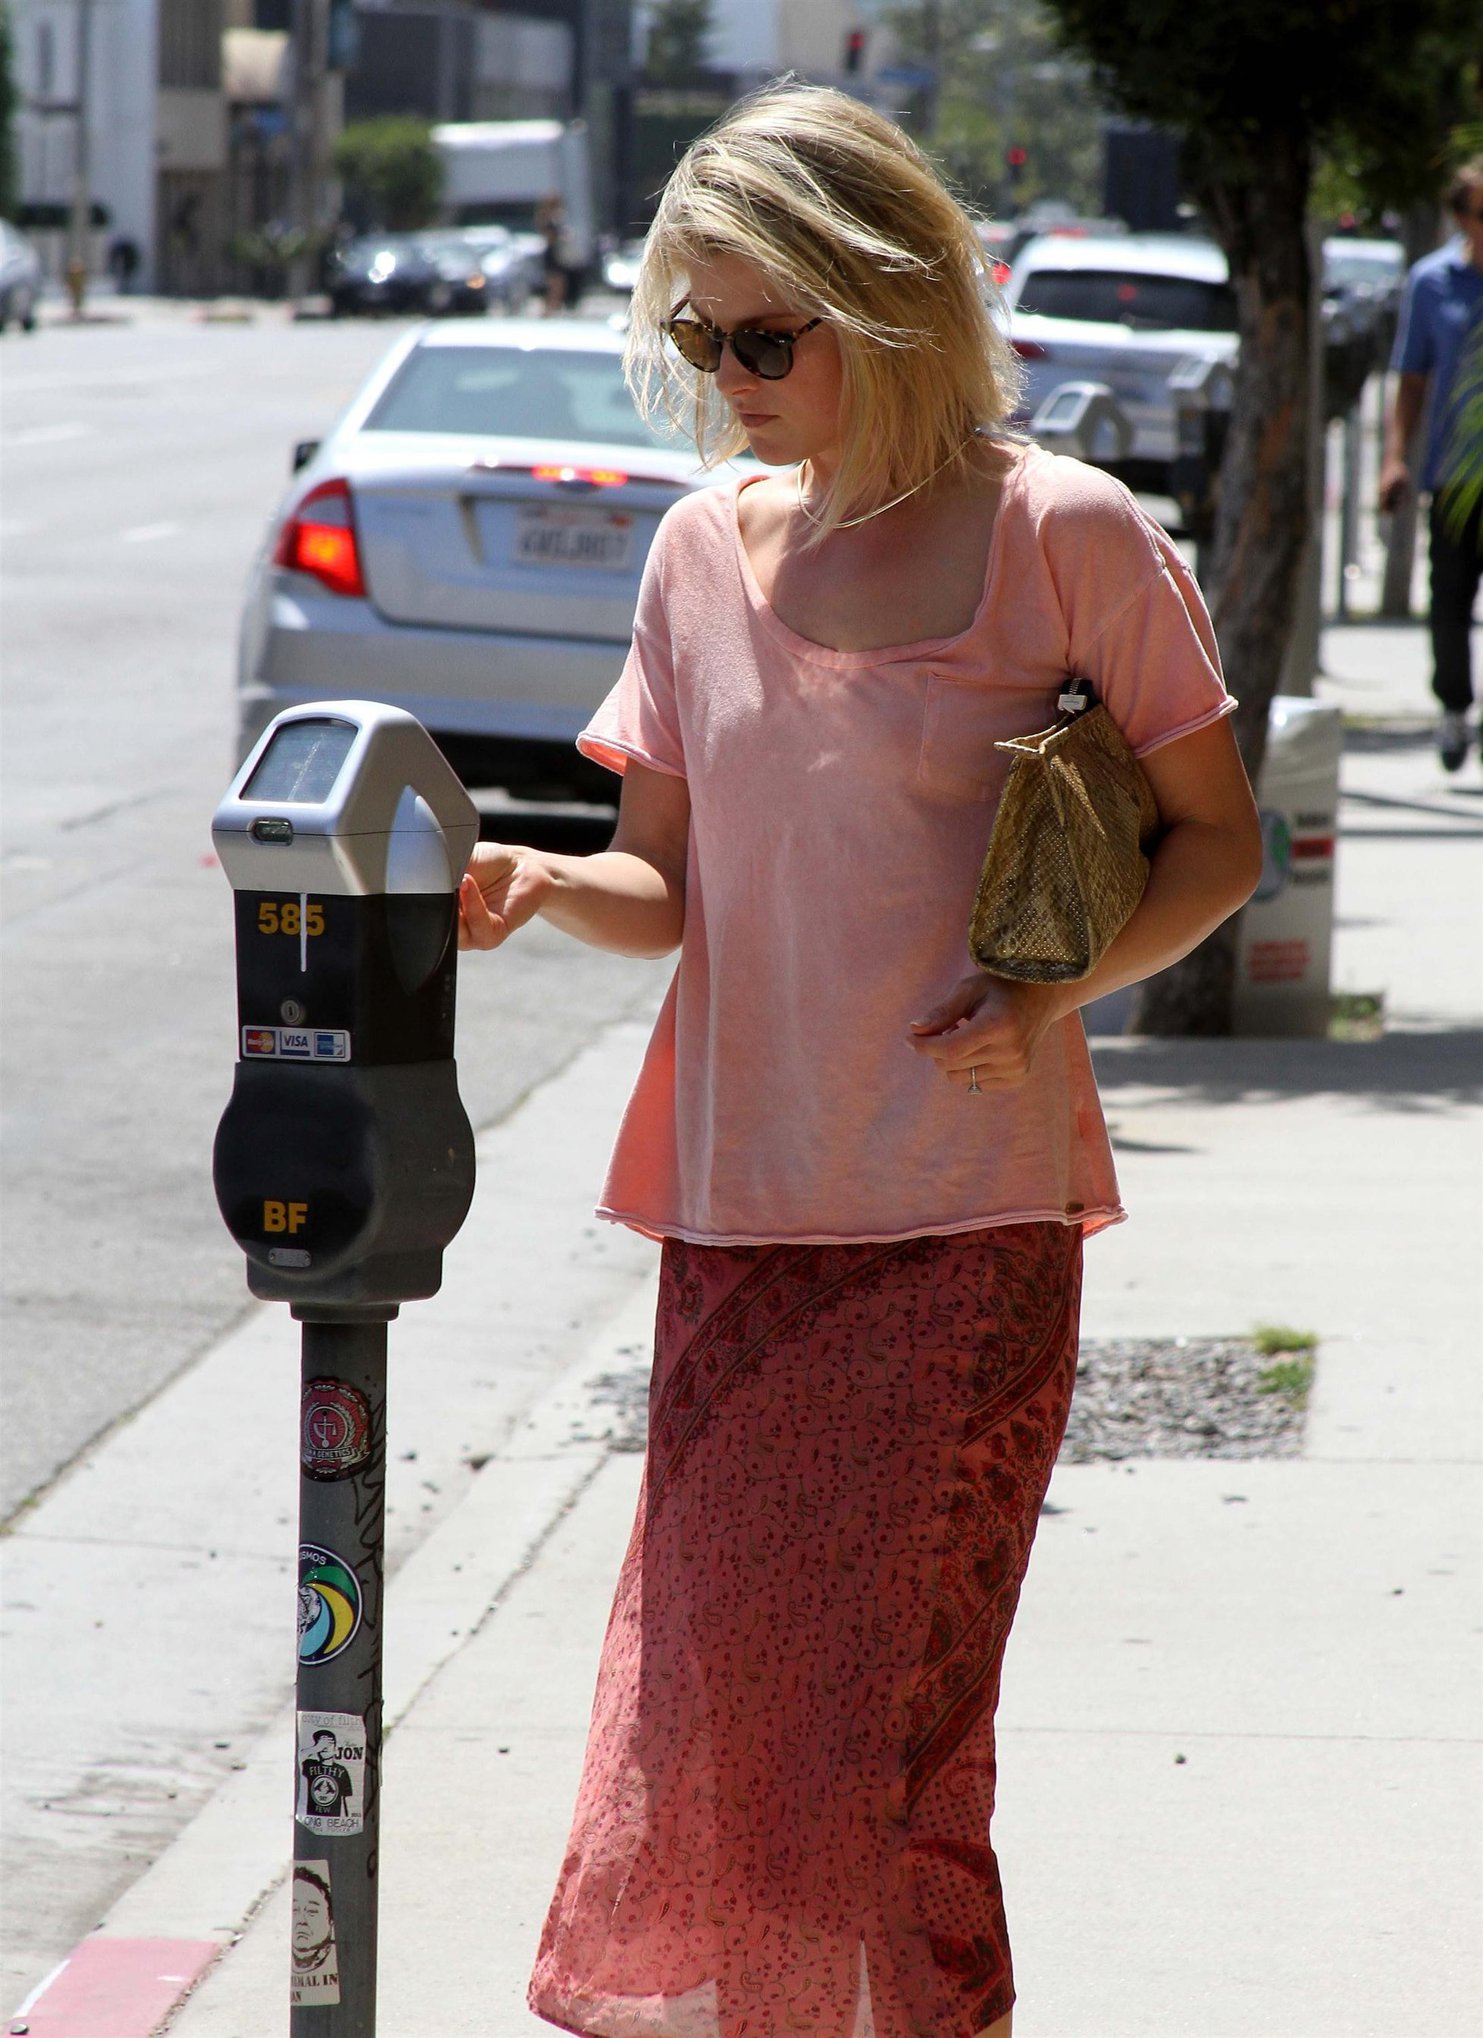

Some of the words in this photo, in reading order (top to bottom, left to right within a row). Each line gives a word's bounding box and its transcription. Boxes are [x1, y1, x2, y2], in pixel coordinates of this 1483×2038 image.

[258, 902, 326, 937] 585
[284, 1035, 309, 1047] VISA
[263, 1200, 308, 1234] BF
[316, 1449, 351, 1459] GENETICS
[334, 1747, 364, 1760] JON
[309, 1765, 346, 1778] FILTHY
[315, 1806, 331, 1814] FEW
[304, 1816, 322, 1828] ONG
[327, 1818, 359, 1828] BEACH
